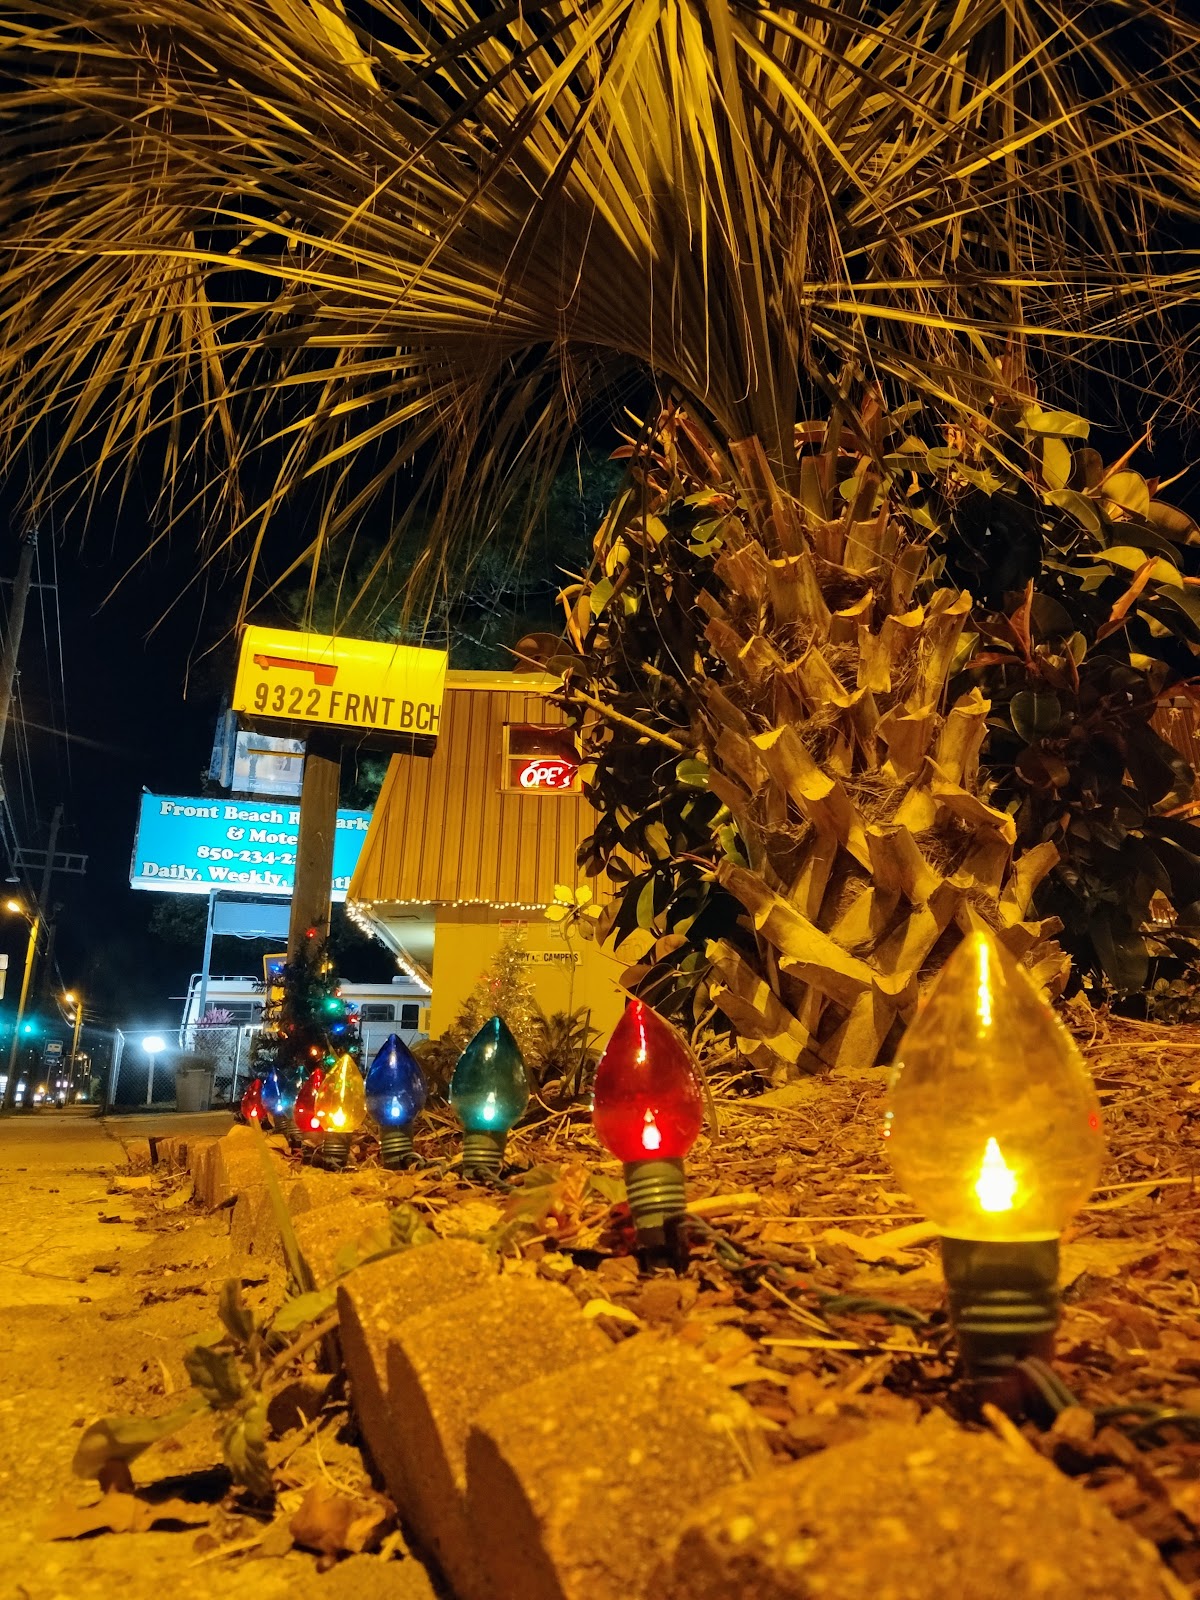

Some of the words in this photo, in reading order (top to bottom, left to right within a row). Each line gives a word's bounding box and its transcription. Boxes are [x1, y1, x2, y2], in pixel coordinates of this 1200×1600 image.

[254, 683, 321, 717] 9322
[328, 690, 395, 726] FRNT
[400, 700, 442, 732] BCH
[159, 801, 220, 819] Front
[223, 806, 283, 824] Beach
[288, 811, 301, 825] R
[336, 817, 370, 831] ark
[226, 826, 245, 841] &
[248, 828, 298, 845] Mote
[196, 845, 297, 865] 850-234-2
[141, 862, 203, 881] Daily,
[207, 866, 288, 887] Weekly,
